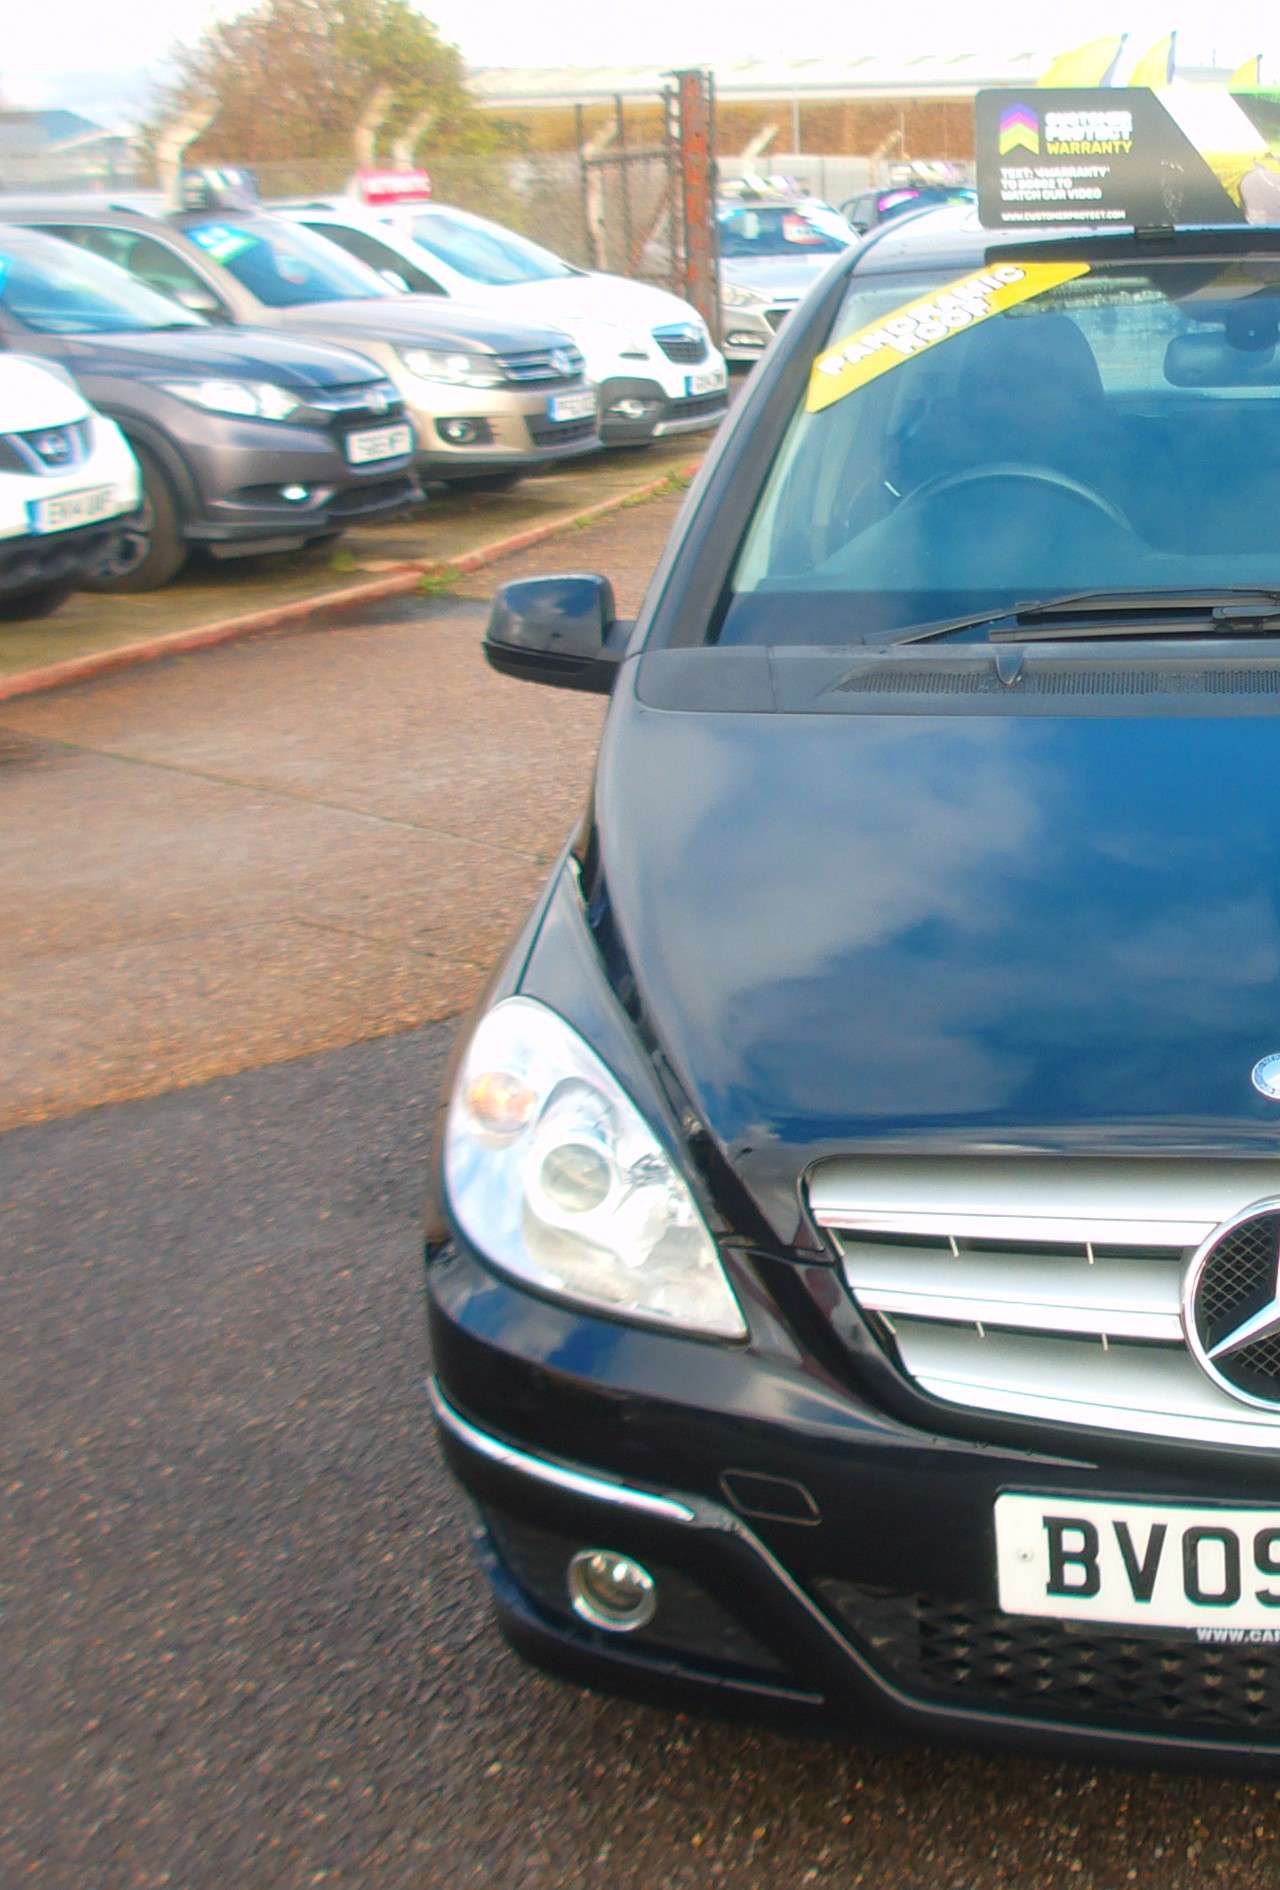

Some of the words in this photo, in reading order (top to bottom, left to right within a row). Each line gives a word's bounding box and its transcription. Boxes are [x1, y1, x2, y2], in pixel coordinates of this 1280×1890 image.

[1046, 139, 1132, 154] WARRANTY
[1001, 179, 1016, 190] TO
[1057, 178, 1072, 188] TO
[1068, 188, 1102, 199] VIDEO
[816, 266, 1026, 376] PANORAMIC
[893, 297, 991, 355] ROOF
